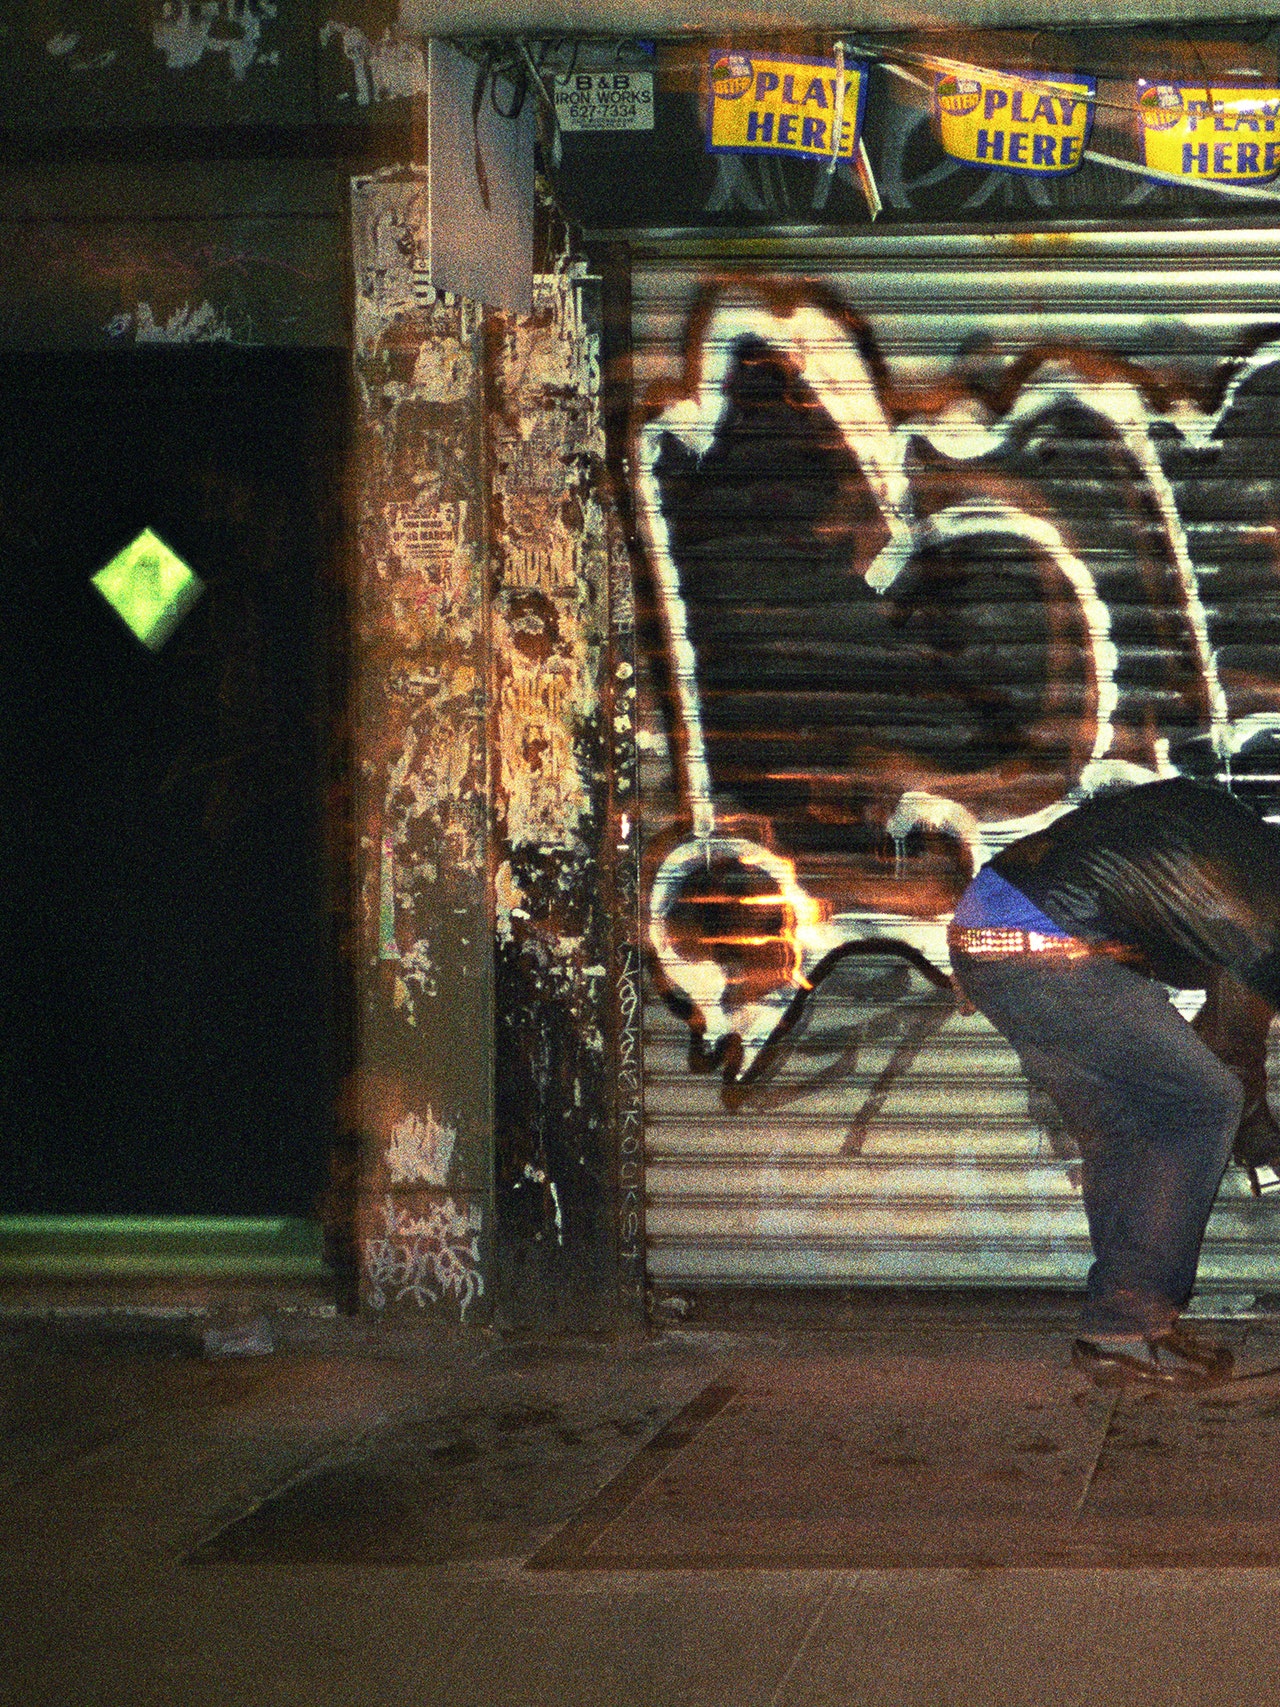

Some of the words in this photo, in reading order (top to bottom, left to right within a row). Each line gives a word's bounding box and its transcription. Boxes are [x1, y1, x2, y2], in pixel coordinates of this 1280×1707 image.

[555, 91, 591, 105] IRON
[597, 90, 652, 104] WORKS
[755, 71, 852, 110] PLAY
[984, 88, 1078, 126] PLAY
[746, 111, 851, 152] HERE
[977, 130, 1080, 166] HERE
